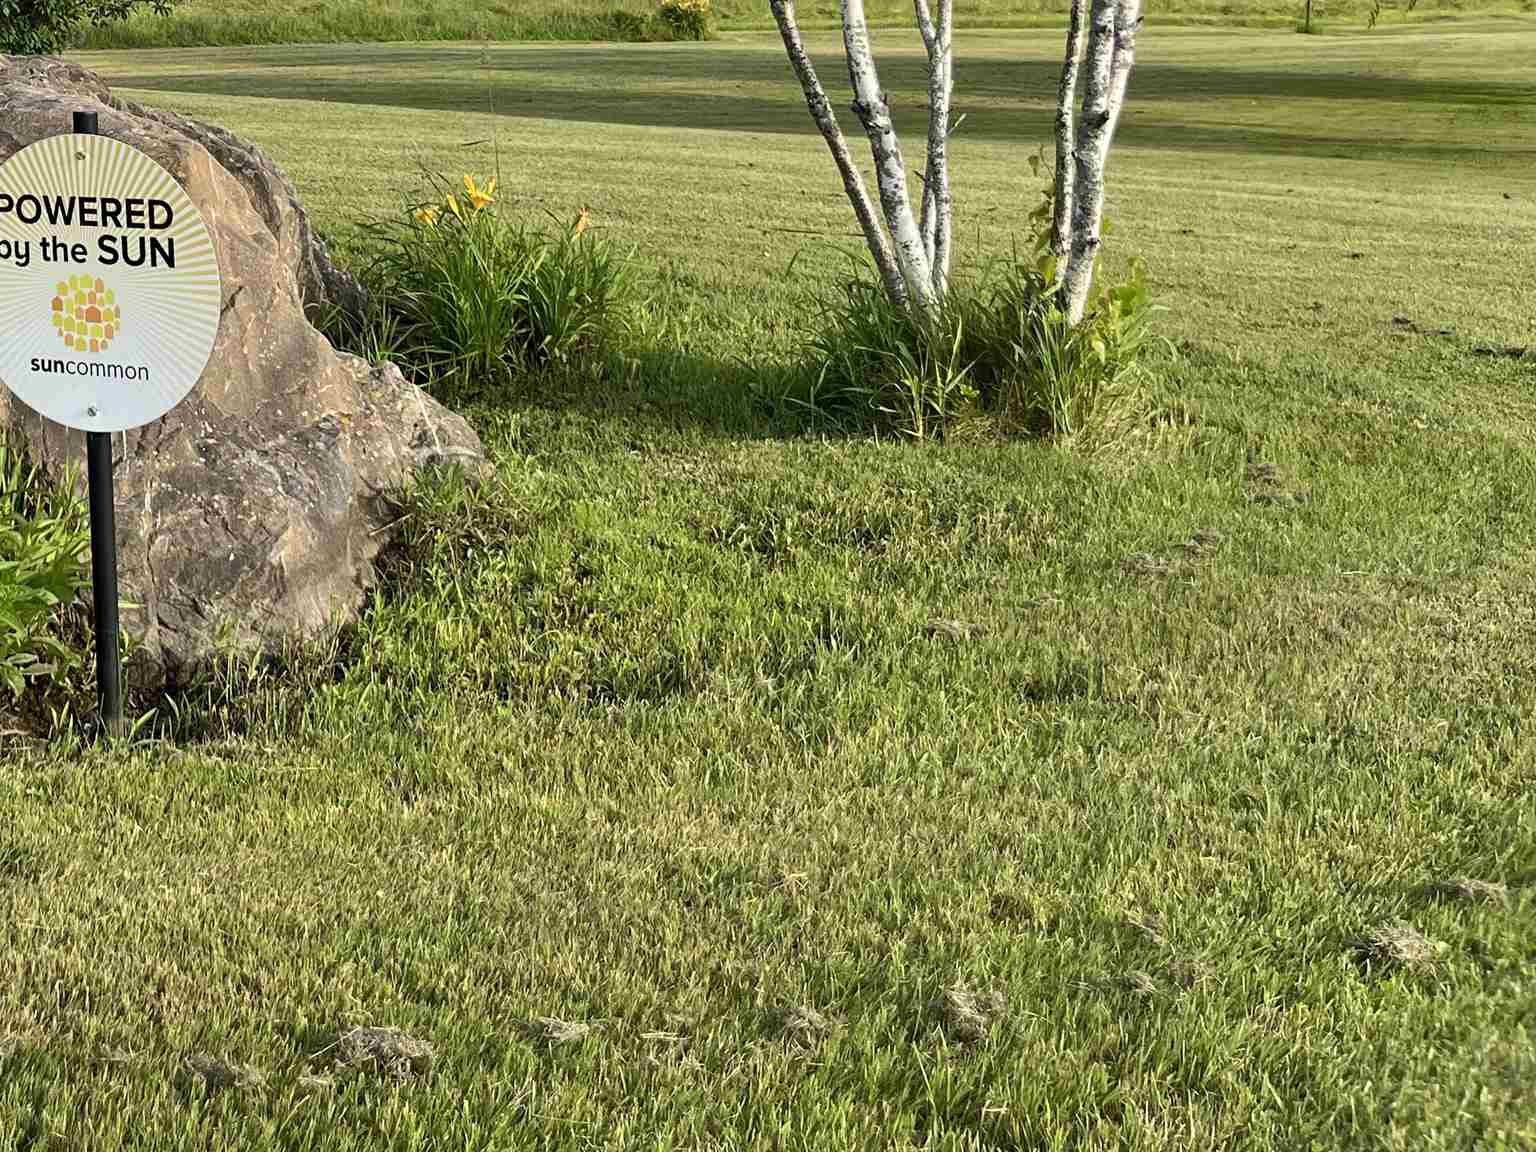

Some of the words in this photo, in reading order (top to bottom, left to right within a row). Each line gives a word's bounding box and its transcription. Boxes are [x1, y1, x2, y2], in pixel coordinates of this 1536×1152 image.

[40, 236, 88, 263] the
[97, 234, 175, 268] SUN
[31, 357, 149, 380] suncommon
